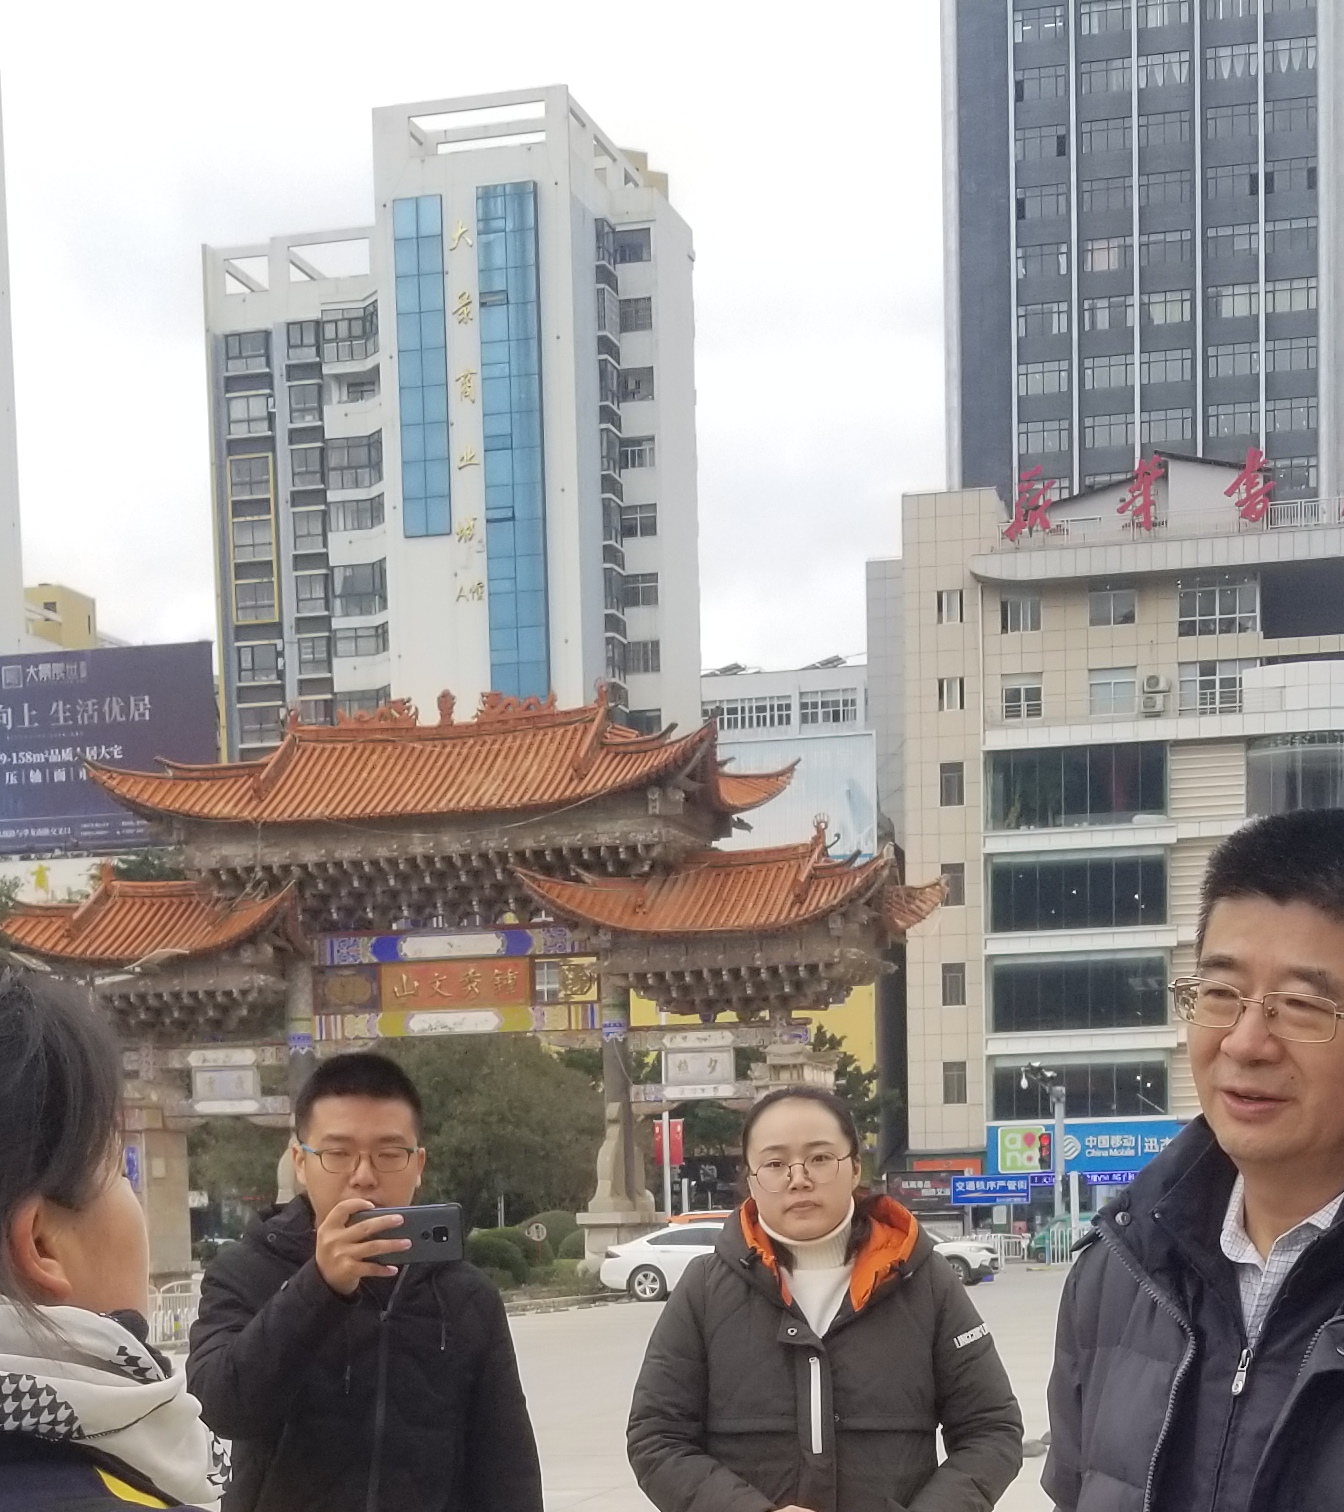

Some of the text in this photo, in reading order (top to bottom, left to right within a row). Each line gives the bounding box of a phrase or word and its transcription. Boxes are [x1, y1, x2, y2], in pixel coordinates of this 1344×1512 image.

[49, 694, 151, 726] 生活优居
[1085, 1135, 1135, 1148] 中国移动
[1085, 1148, 1135, 1158] China Mobile
[956, 1180, 1027, 1192] 交通秩序严管街
